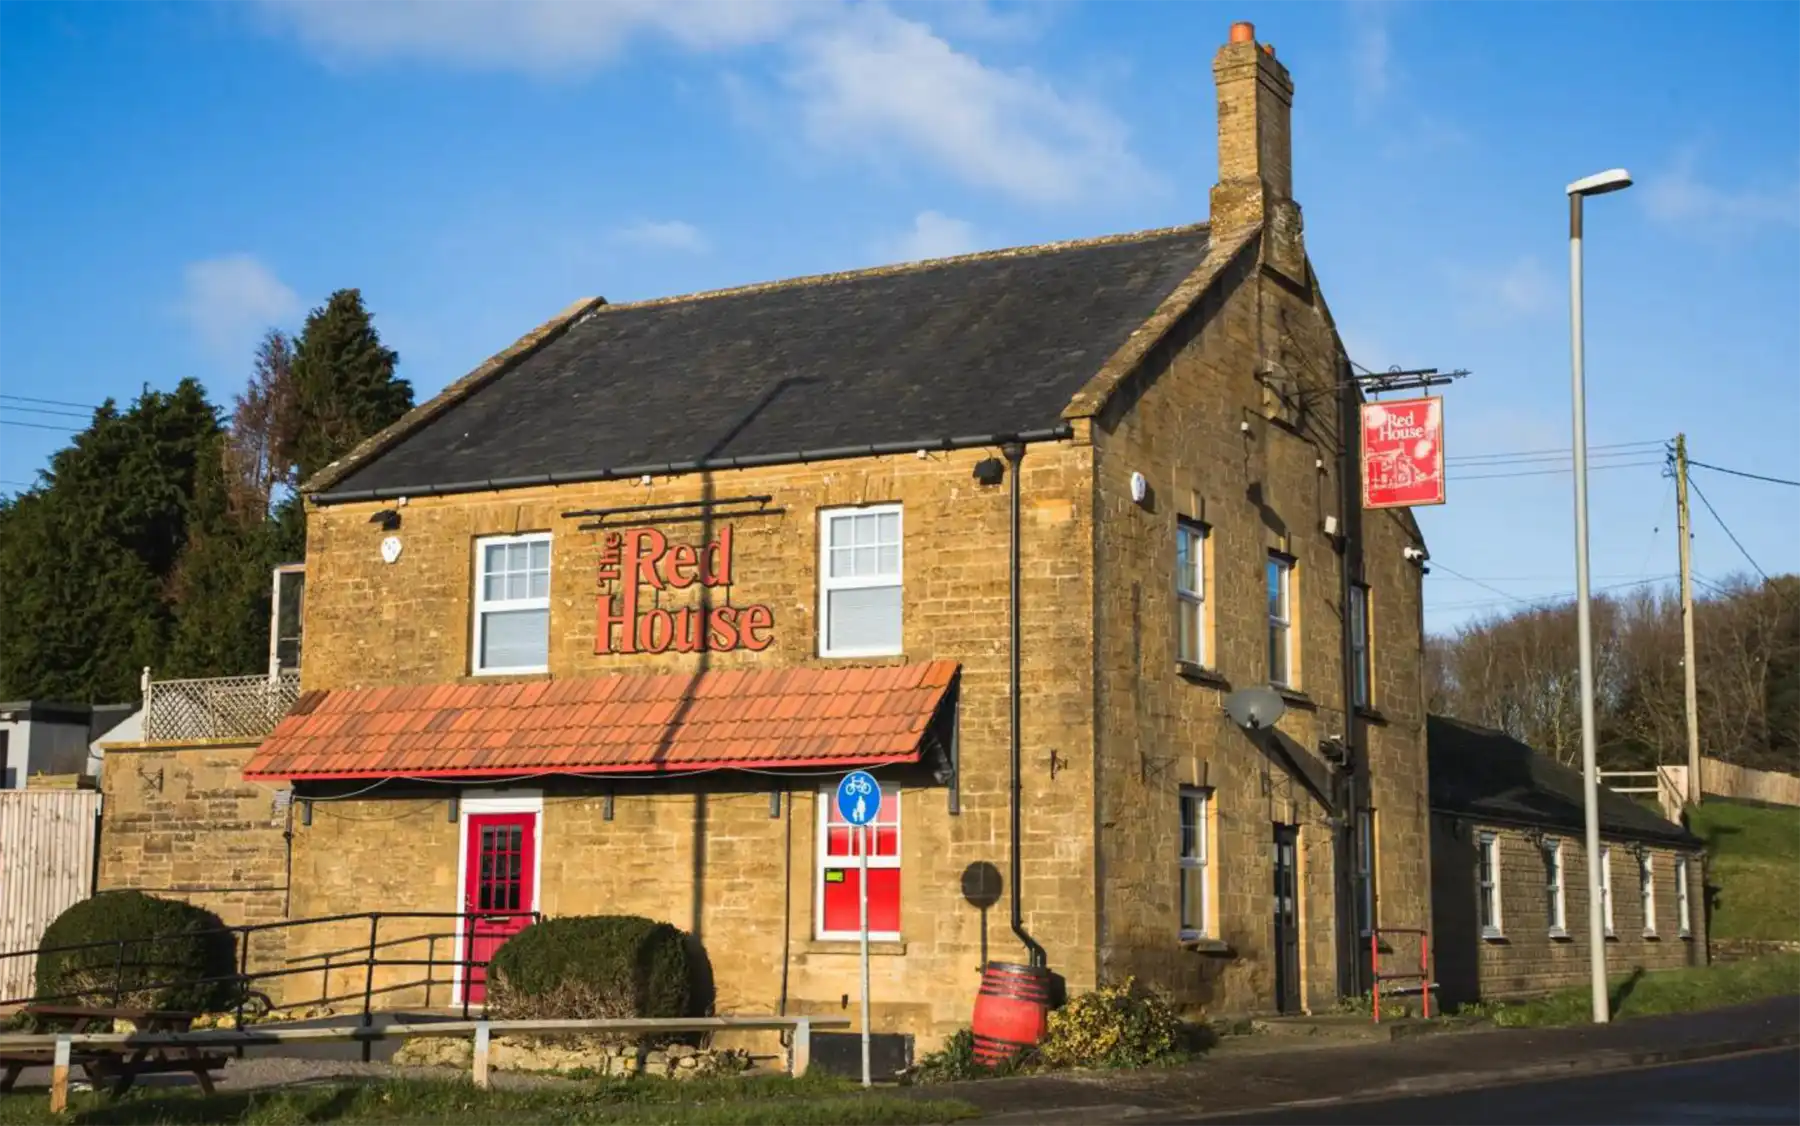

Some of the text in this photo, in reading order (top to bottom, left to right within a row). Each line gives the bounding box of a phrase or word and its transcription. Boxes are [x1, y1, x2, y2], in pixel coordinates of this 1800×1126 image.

[1379, 426, 1424, 441] House
[1388, 410, 1414, 426] Red
[598, 532, 622, 587] The
[625, 524, 734, 590] Red
[595, 595, 774, 655] House
